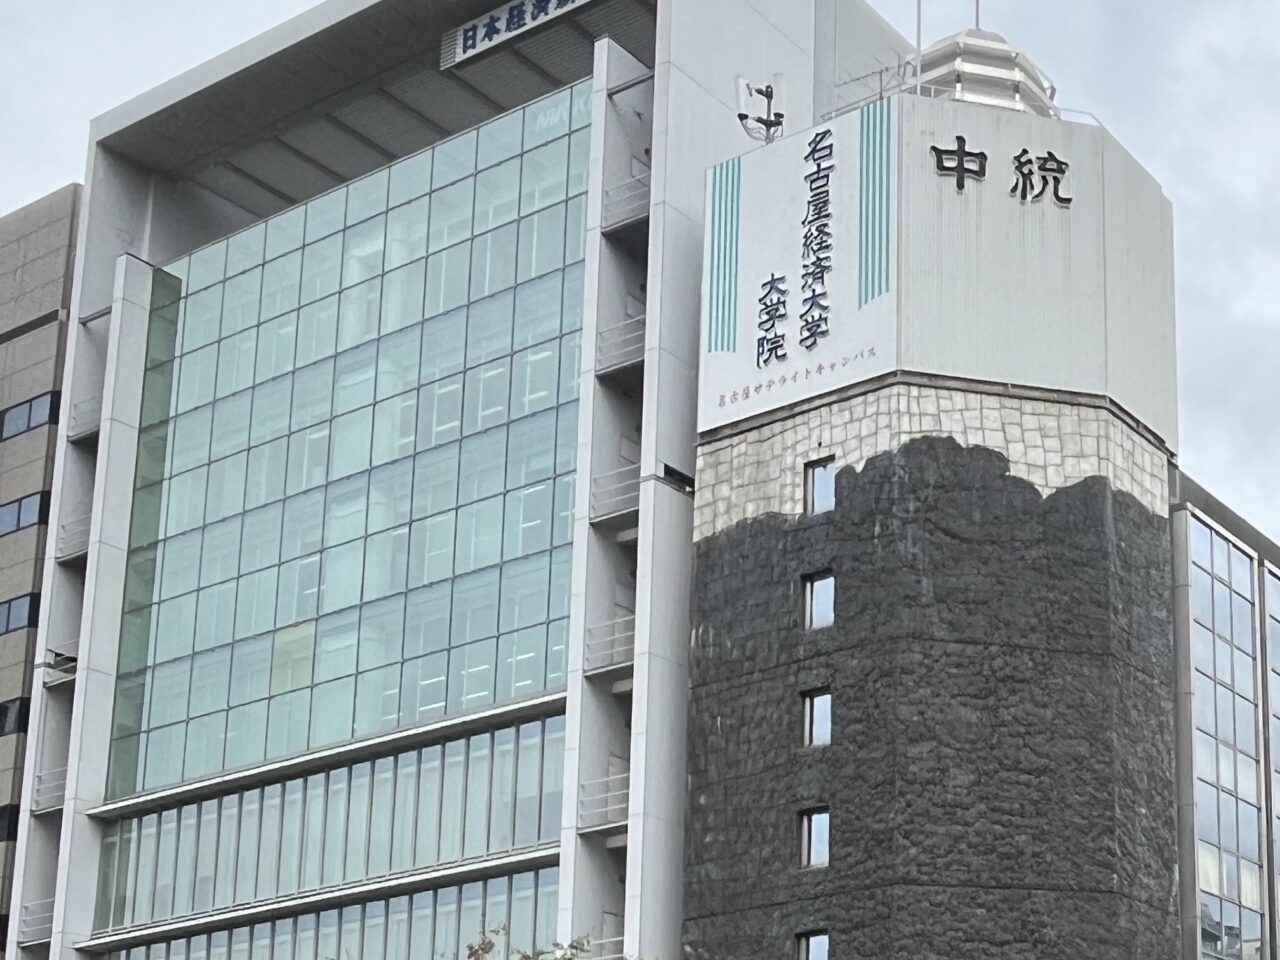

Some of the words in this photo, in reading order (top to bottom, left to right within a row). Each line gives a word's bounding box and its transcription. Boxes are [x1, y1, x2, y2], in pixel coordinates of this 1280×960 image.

[798, 128, 836, 351] 名古屋経済大学
[757, 272, 788, 369] 大学院
[718, 346, 876, 408] 名古屋サテライトキャンパス
